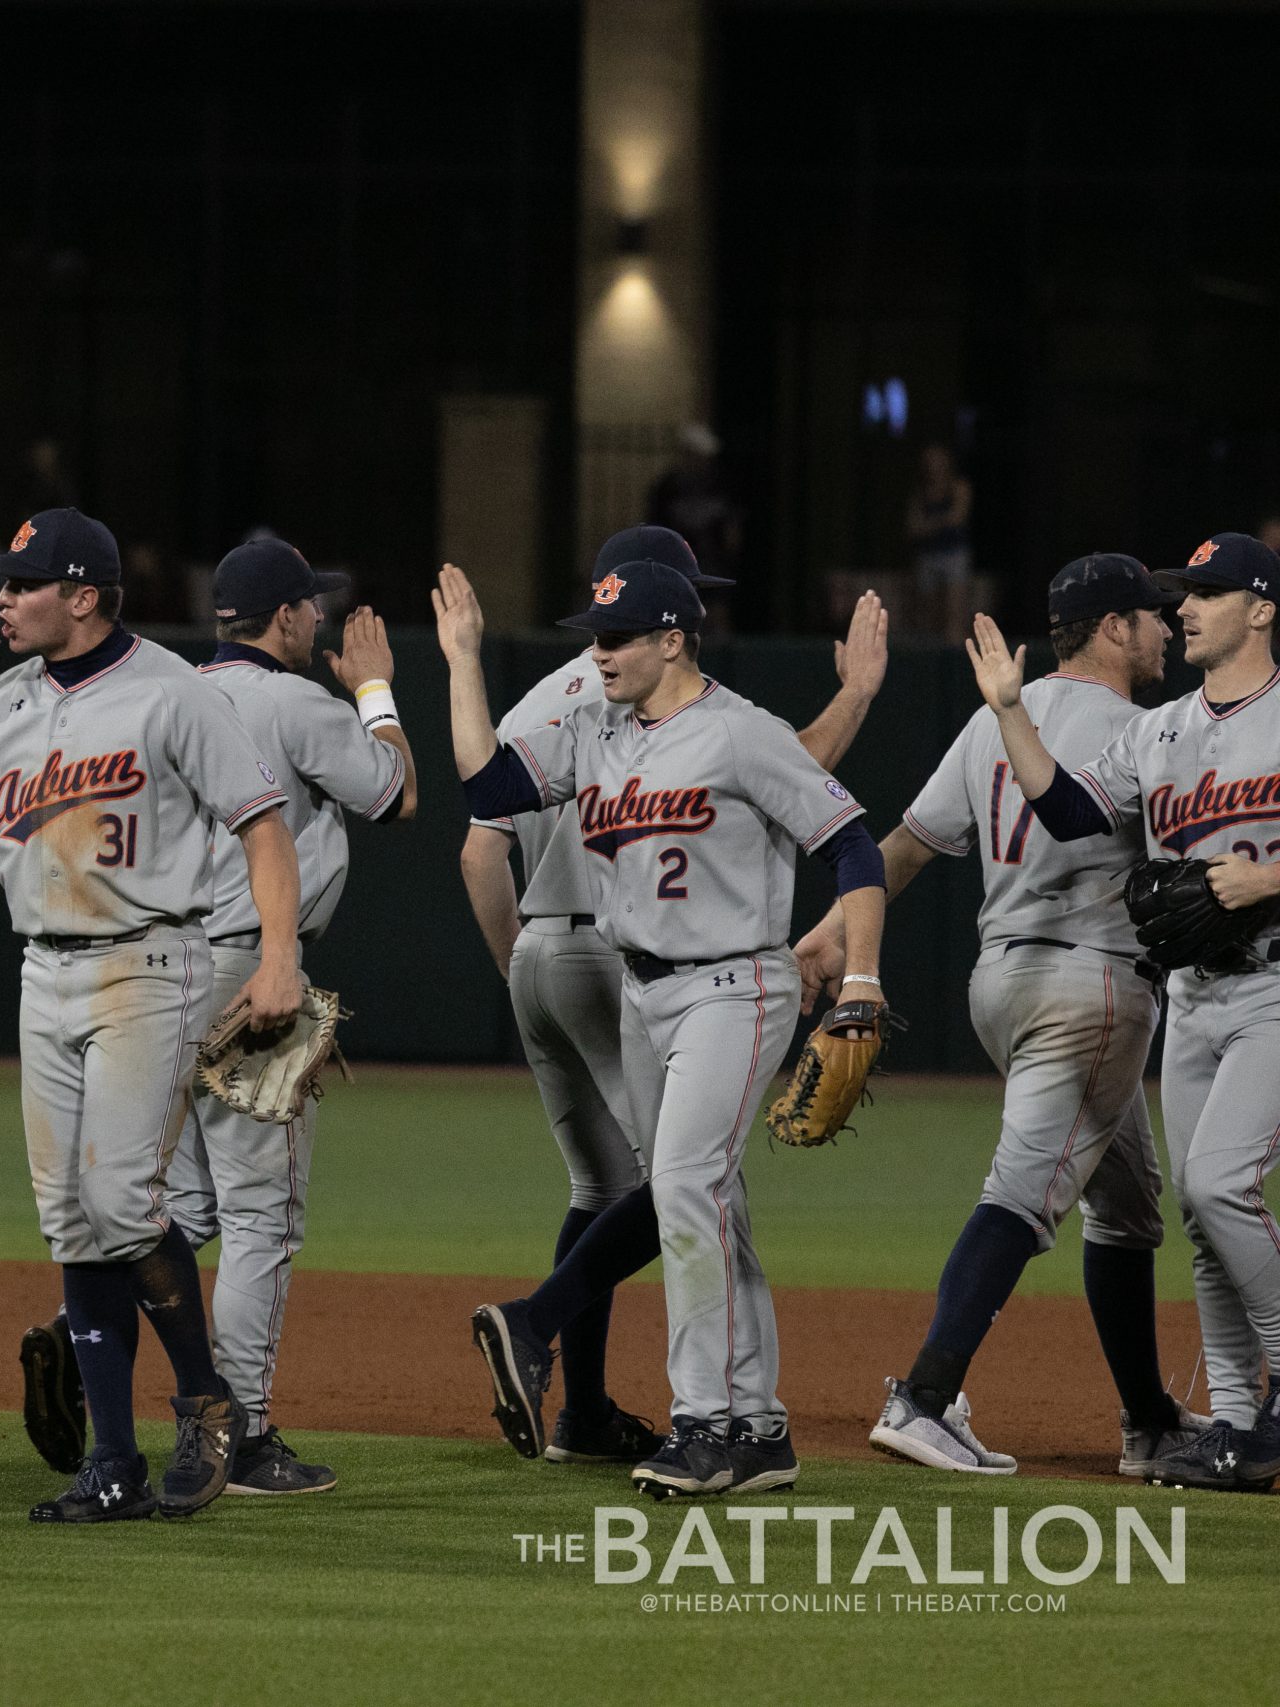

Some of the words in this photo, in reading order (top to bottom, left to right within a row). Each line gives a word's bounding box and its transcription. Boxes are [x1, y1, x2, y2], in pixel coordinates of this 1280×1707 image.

[96, 813, 138, 867] 31
[576, 776, 716, 848] Auburn
[1148, 769, 1280, 848] Auburn
[657, 847, 688, 900] 2
